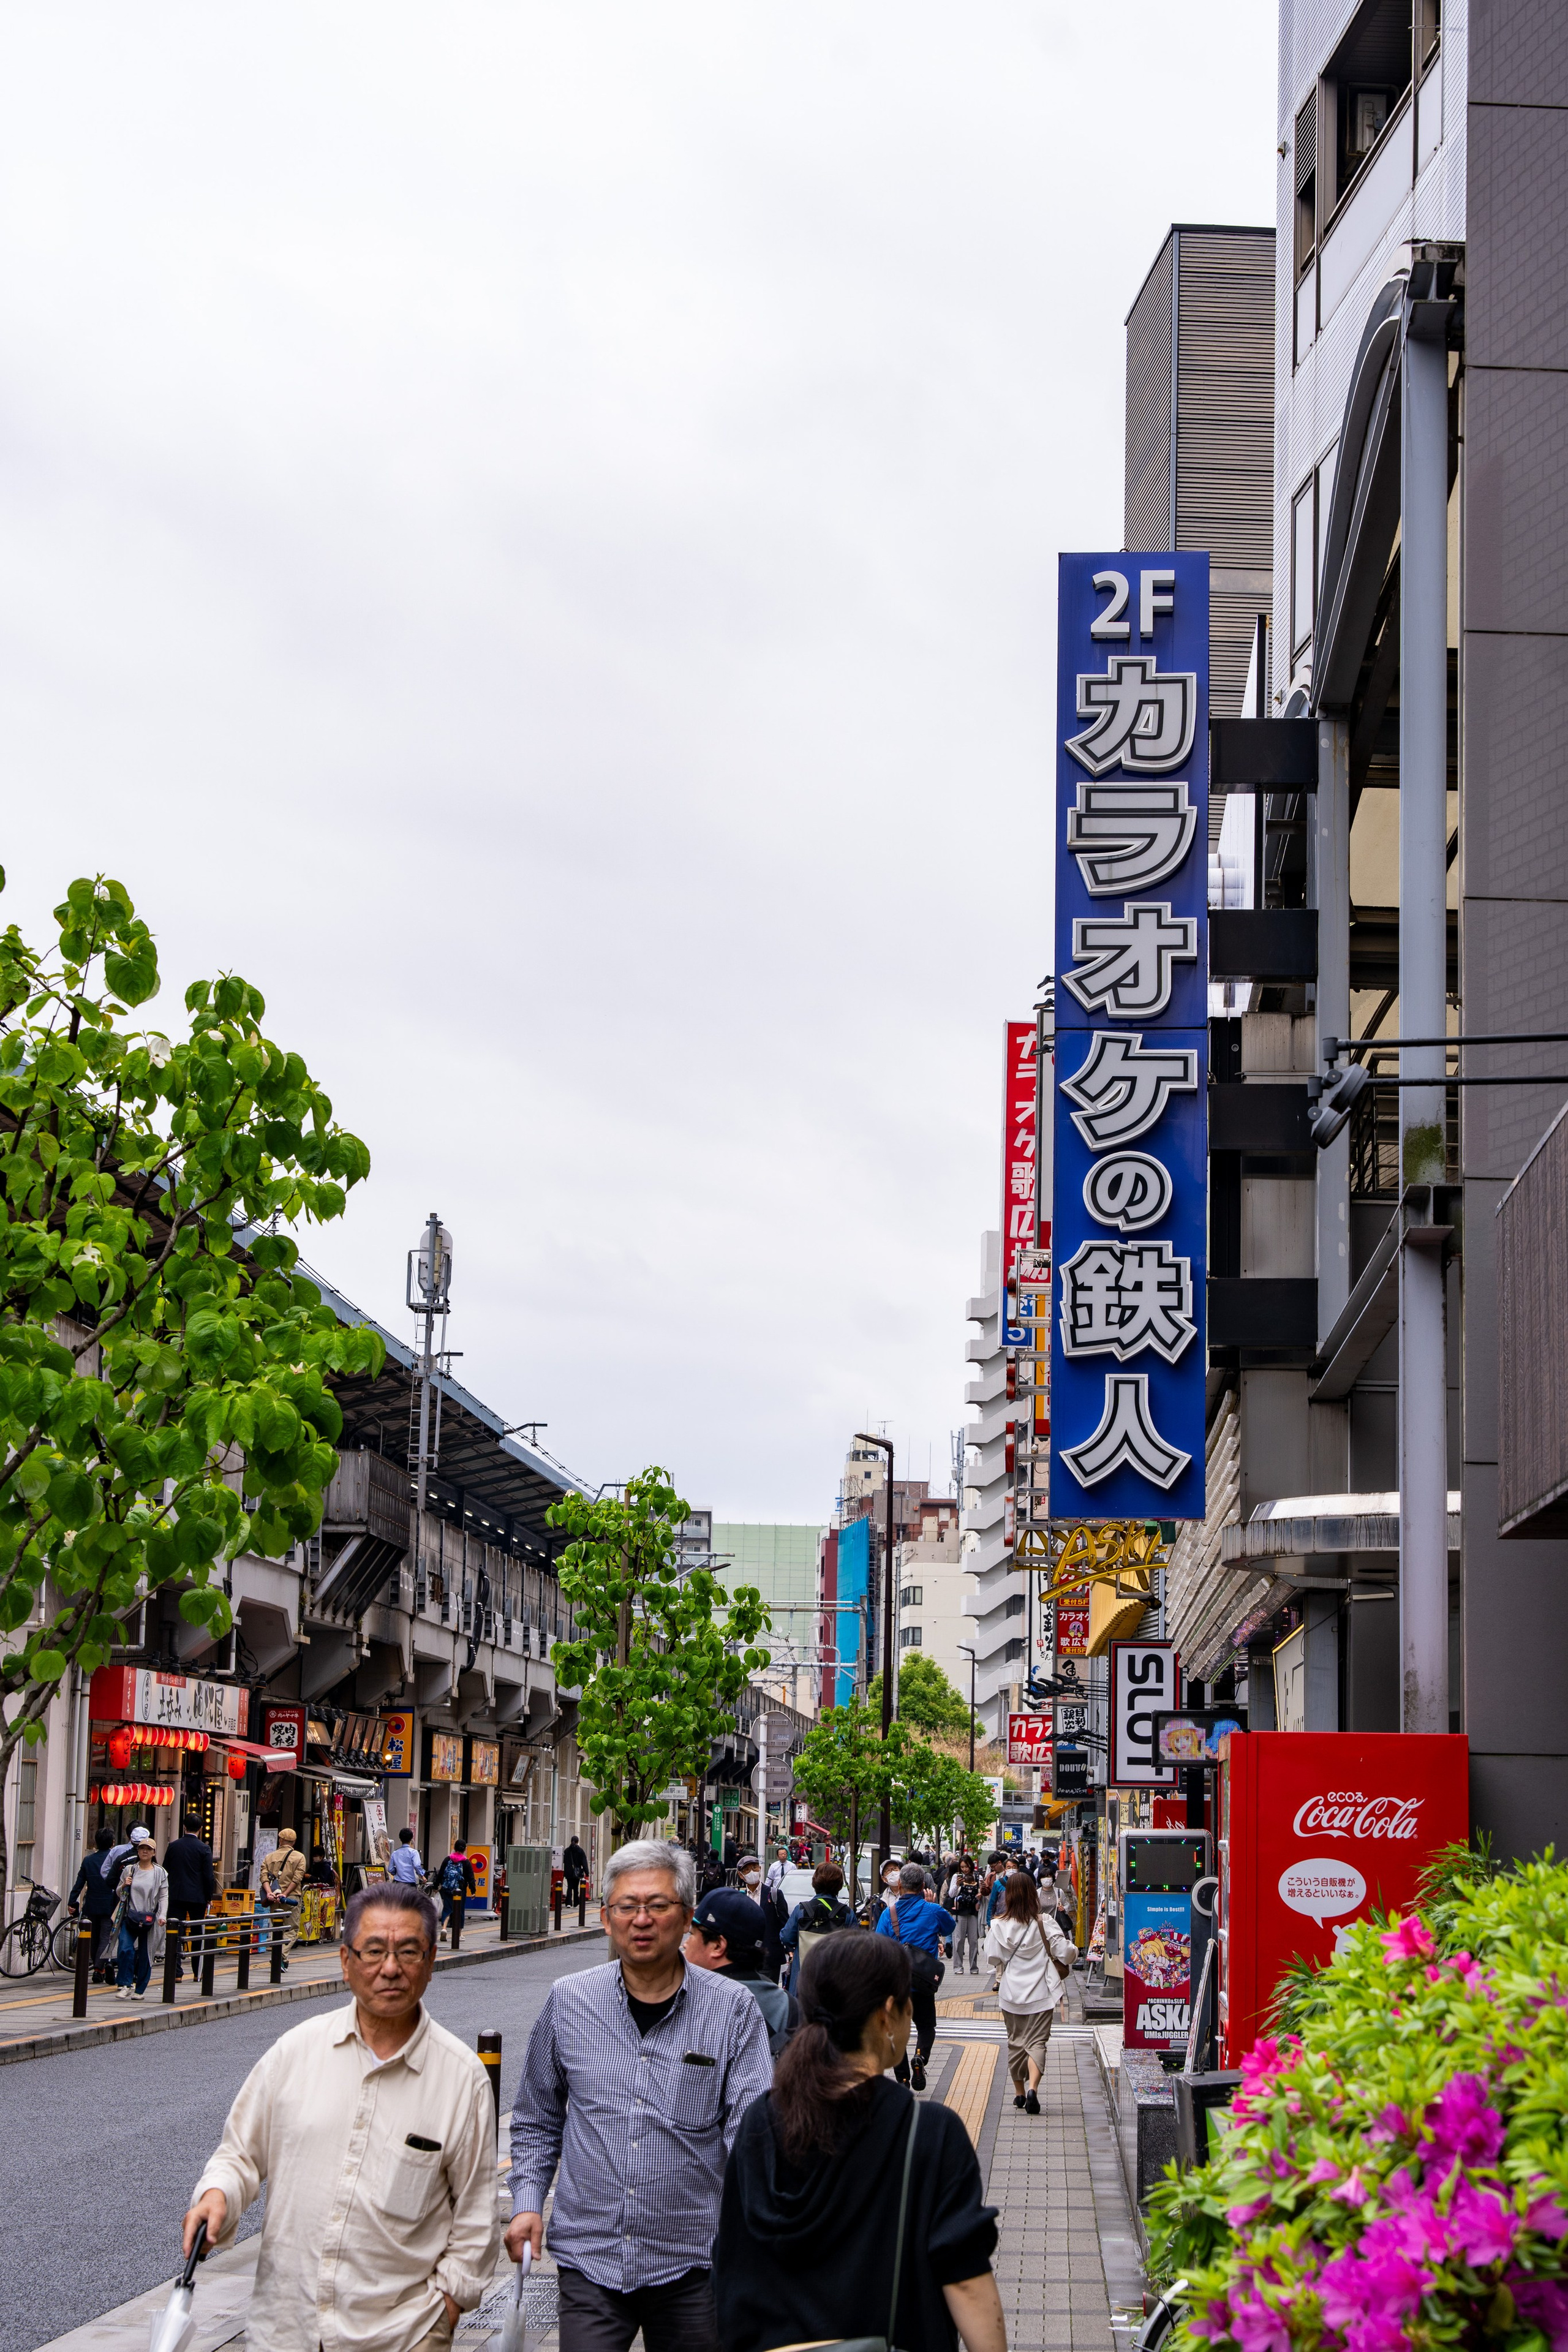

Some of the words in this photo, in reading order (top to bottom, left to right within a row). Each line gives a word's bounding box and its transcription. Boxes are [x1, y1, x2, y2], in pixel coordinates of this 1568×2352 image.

[1090, 570, 1175, 638] 2F
[1060, 656, 1197, 1489] カラオケの鉄人
[1060, 1612, 1090, 1621] カラオケ
[1060, 1638, 1088, 1646] 歌広場
[272, 1724, 296, 1736] 焼肉
[272, 1735, 295, 1746] 弁当
[386, 1736, 404, 1770] 松屋
[1059, 1763, 1087, 1772] DOUTO
[1293, 1796, 1425, 1839] Coca-Cola
[1287, 1877, 1355, 1887] こういう自販機が
[1287, 1888, 1359, 1898] 増えるといいなぁ。
